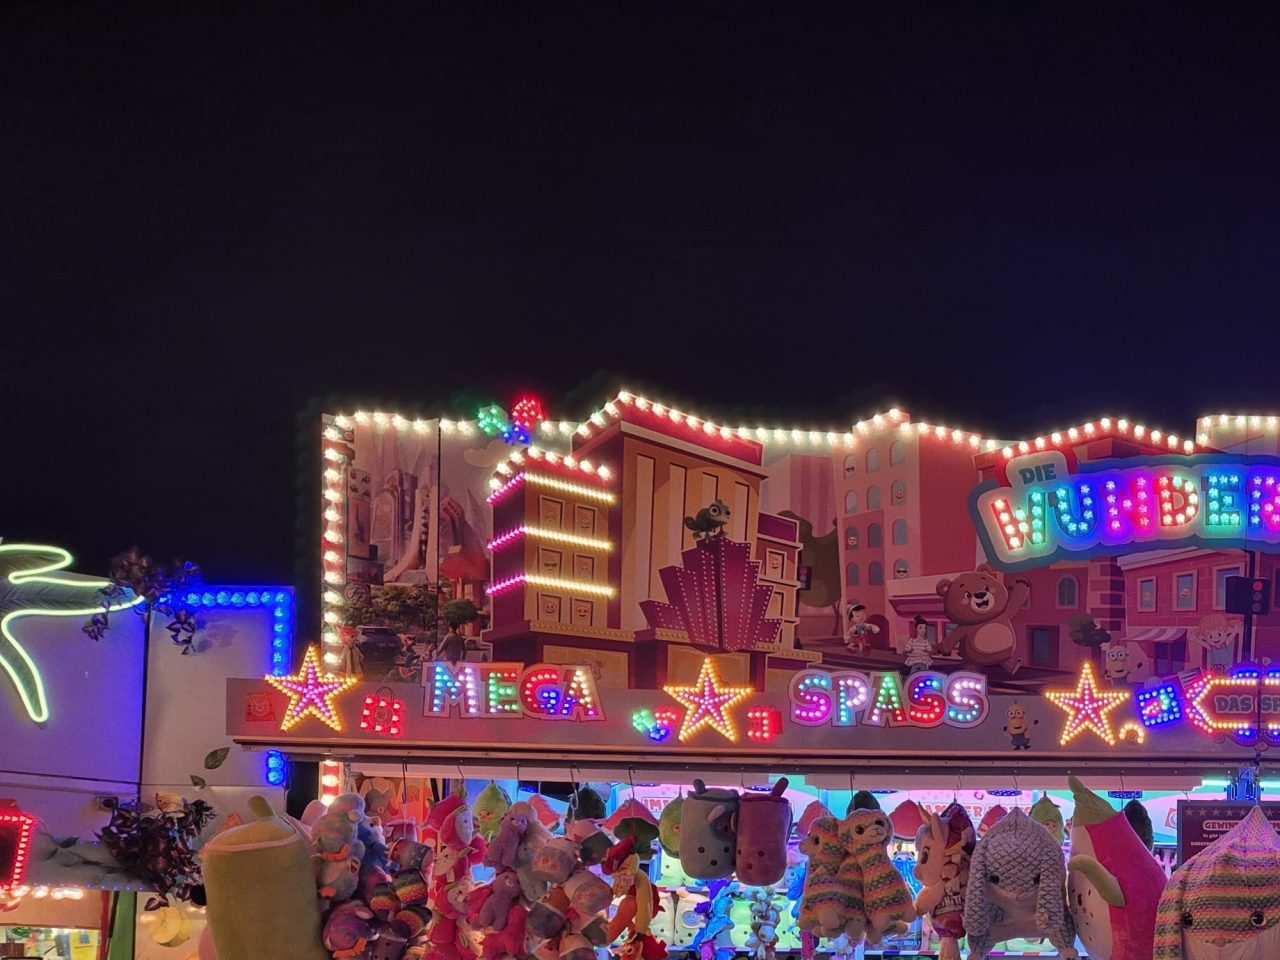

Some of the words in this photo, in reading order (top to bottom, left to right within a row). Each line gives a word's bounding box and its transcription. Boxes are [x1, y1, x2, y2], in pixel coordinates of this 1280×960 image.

[1019, 463, 1057, 485] DIE
[430, 663, 599, 717] MEGA
[799, 672, 983, 725] SPASS
[1215, 696, 1253, 714] DAS
